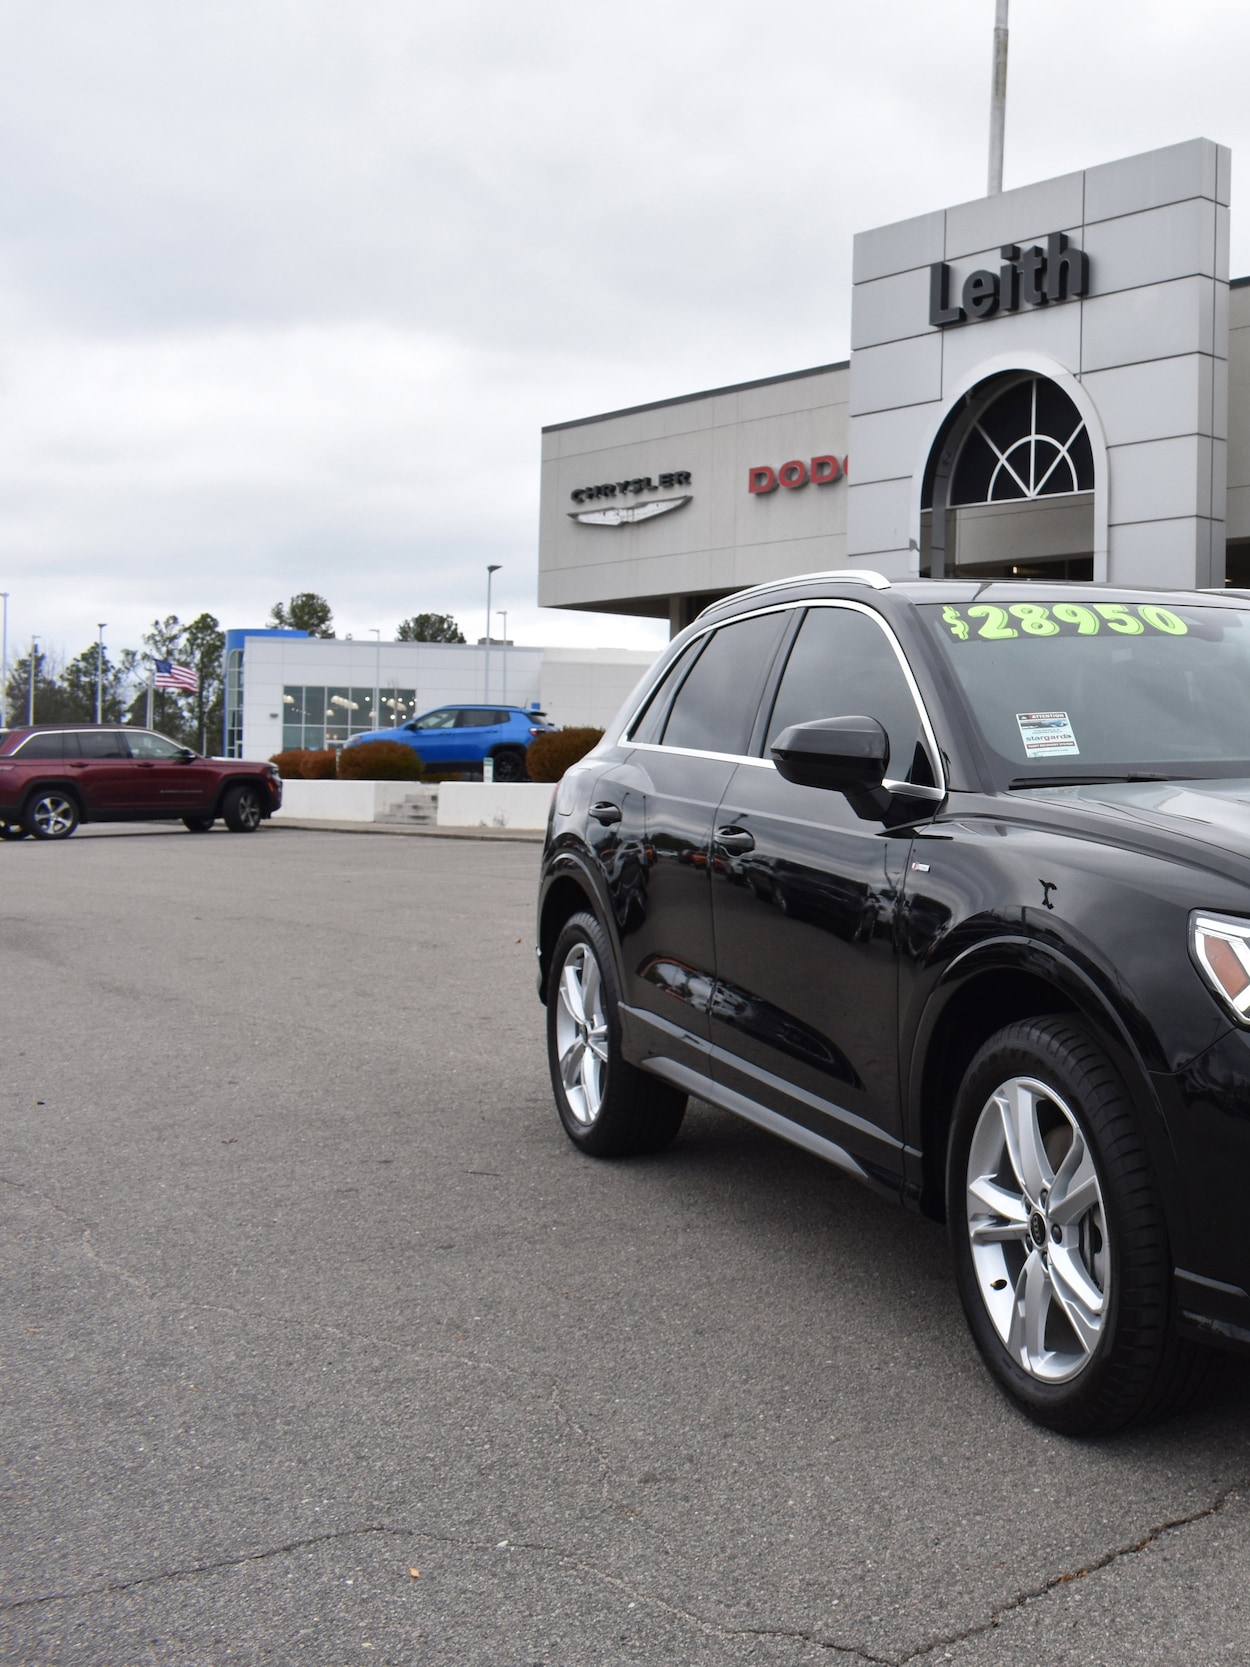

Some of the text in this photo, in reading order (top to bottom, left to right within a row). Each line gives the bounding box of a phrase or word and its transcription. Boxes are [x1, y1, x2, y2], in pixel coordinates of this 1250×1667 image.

[929, 232, 1090, 327] Leith
[571, 470, 692, 503] CHRYSLER
[749, 455, 848, 494] DOD
[942, 603, 1189, 640] $28950
